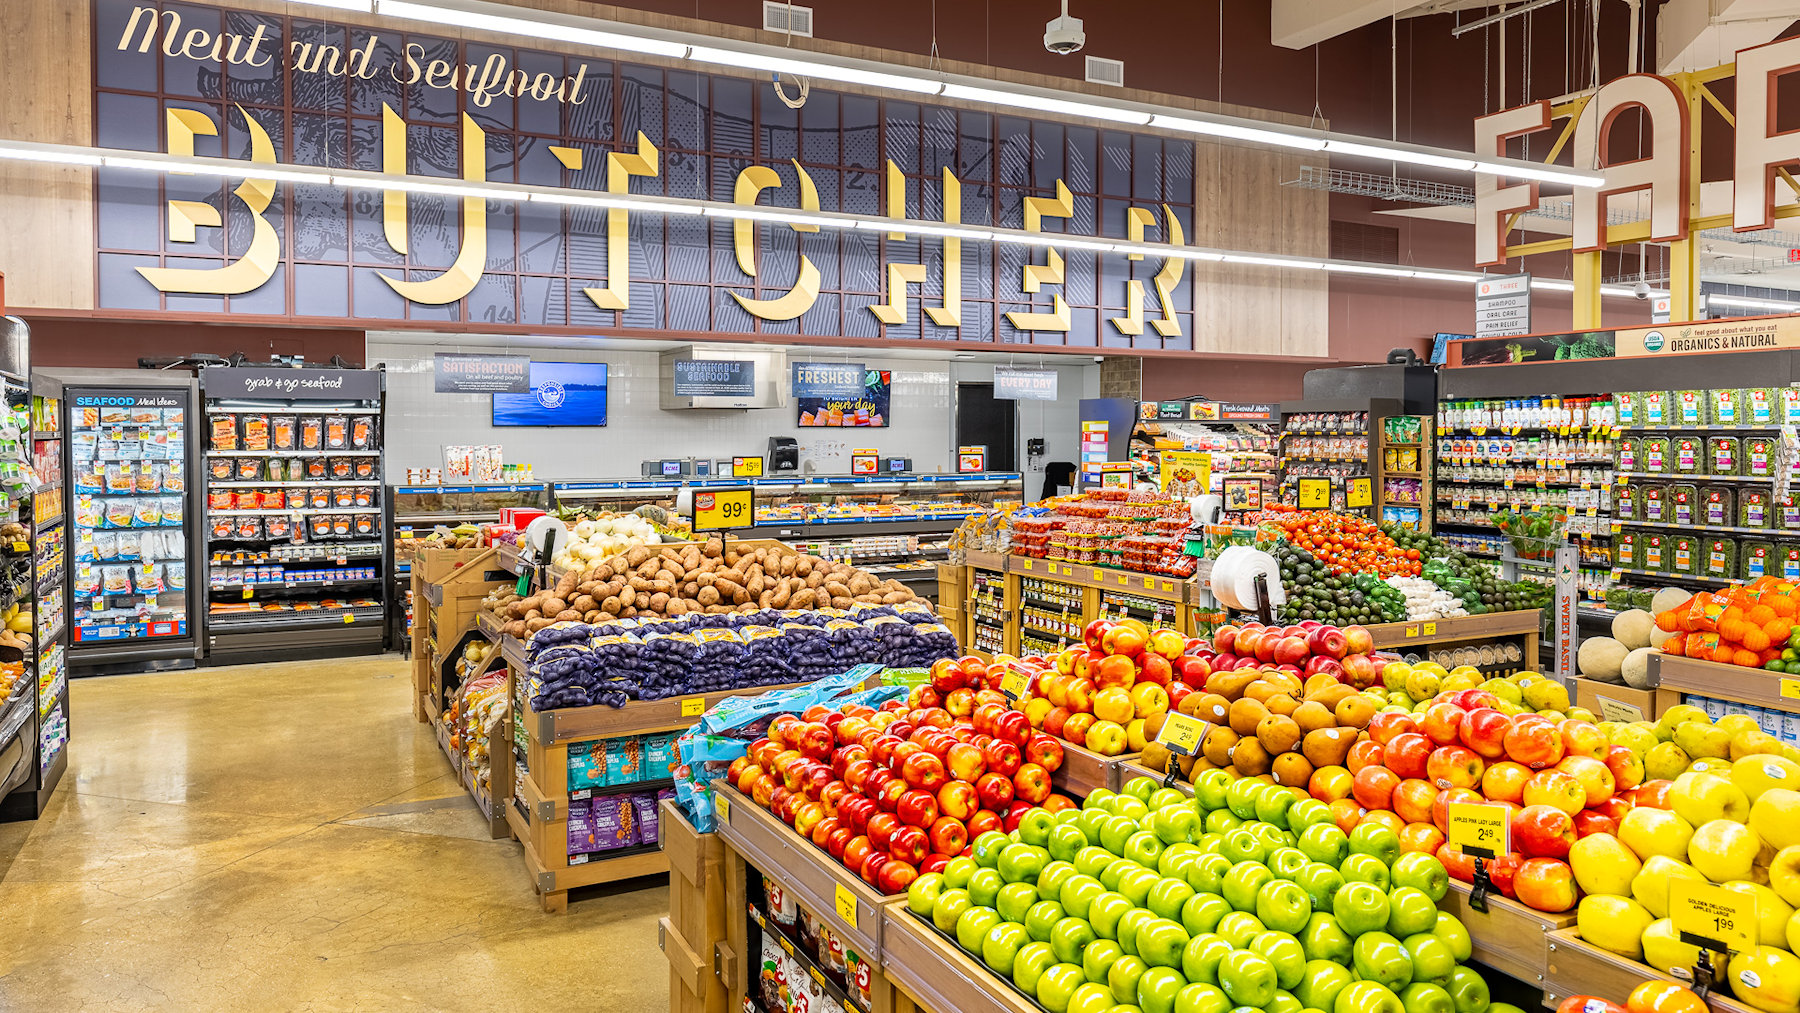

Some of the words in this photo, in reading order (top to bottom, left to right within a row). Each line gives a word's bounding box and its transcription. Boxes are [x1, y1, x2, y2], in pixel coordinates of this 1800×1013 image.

[118, 5, 272, 65] Meat
[281, 35, 378, 81] and
[391, 42, 588, 108] Seafood
[135, 101, 1185, 337] BUTCHER
[1488, 300, 1516, 308] SHAMPOO
[1671, 337, 1720, 352] ORGANICS
[1722, 337, 1729, 348] &
[1731, 334, 1778, 348] NATURAL
[443, 362, 523, 374] SATISFACTION
[677, 362, 740, 373] SUSTAINABLE
[245, 376, 274, 392] grab
[284, 378, 299, 392] go
[301, 376, 343, 389] seafood
[687, 372, 730, 382] SEAFOOD
[798, 371, 860, 384] FRESHEST
[1001, 377, 1030, 388] EVERY
[1033, 378, 1052, 388] DAY
[76, 397, 135, 406] SEAFOOD
[827, 400, 854, 416] your
[854, 398, 876, 417] day
[1561, 596, 1570, 636] SWEET
[1561, 638, 1570, 674] BASIL
[772, 884, 780, 905] $5
[1688, 898, 1708, 907] GOLDEN
[1709, 903, 1736, 913] DELICIOUS
[857, 963, 869, 986] $5
